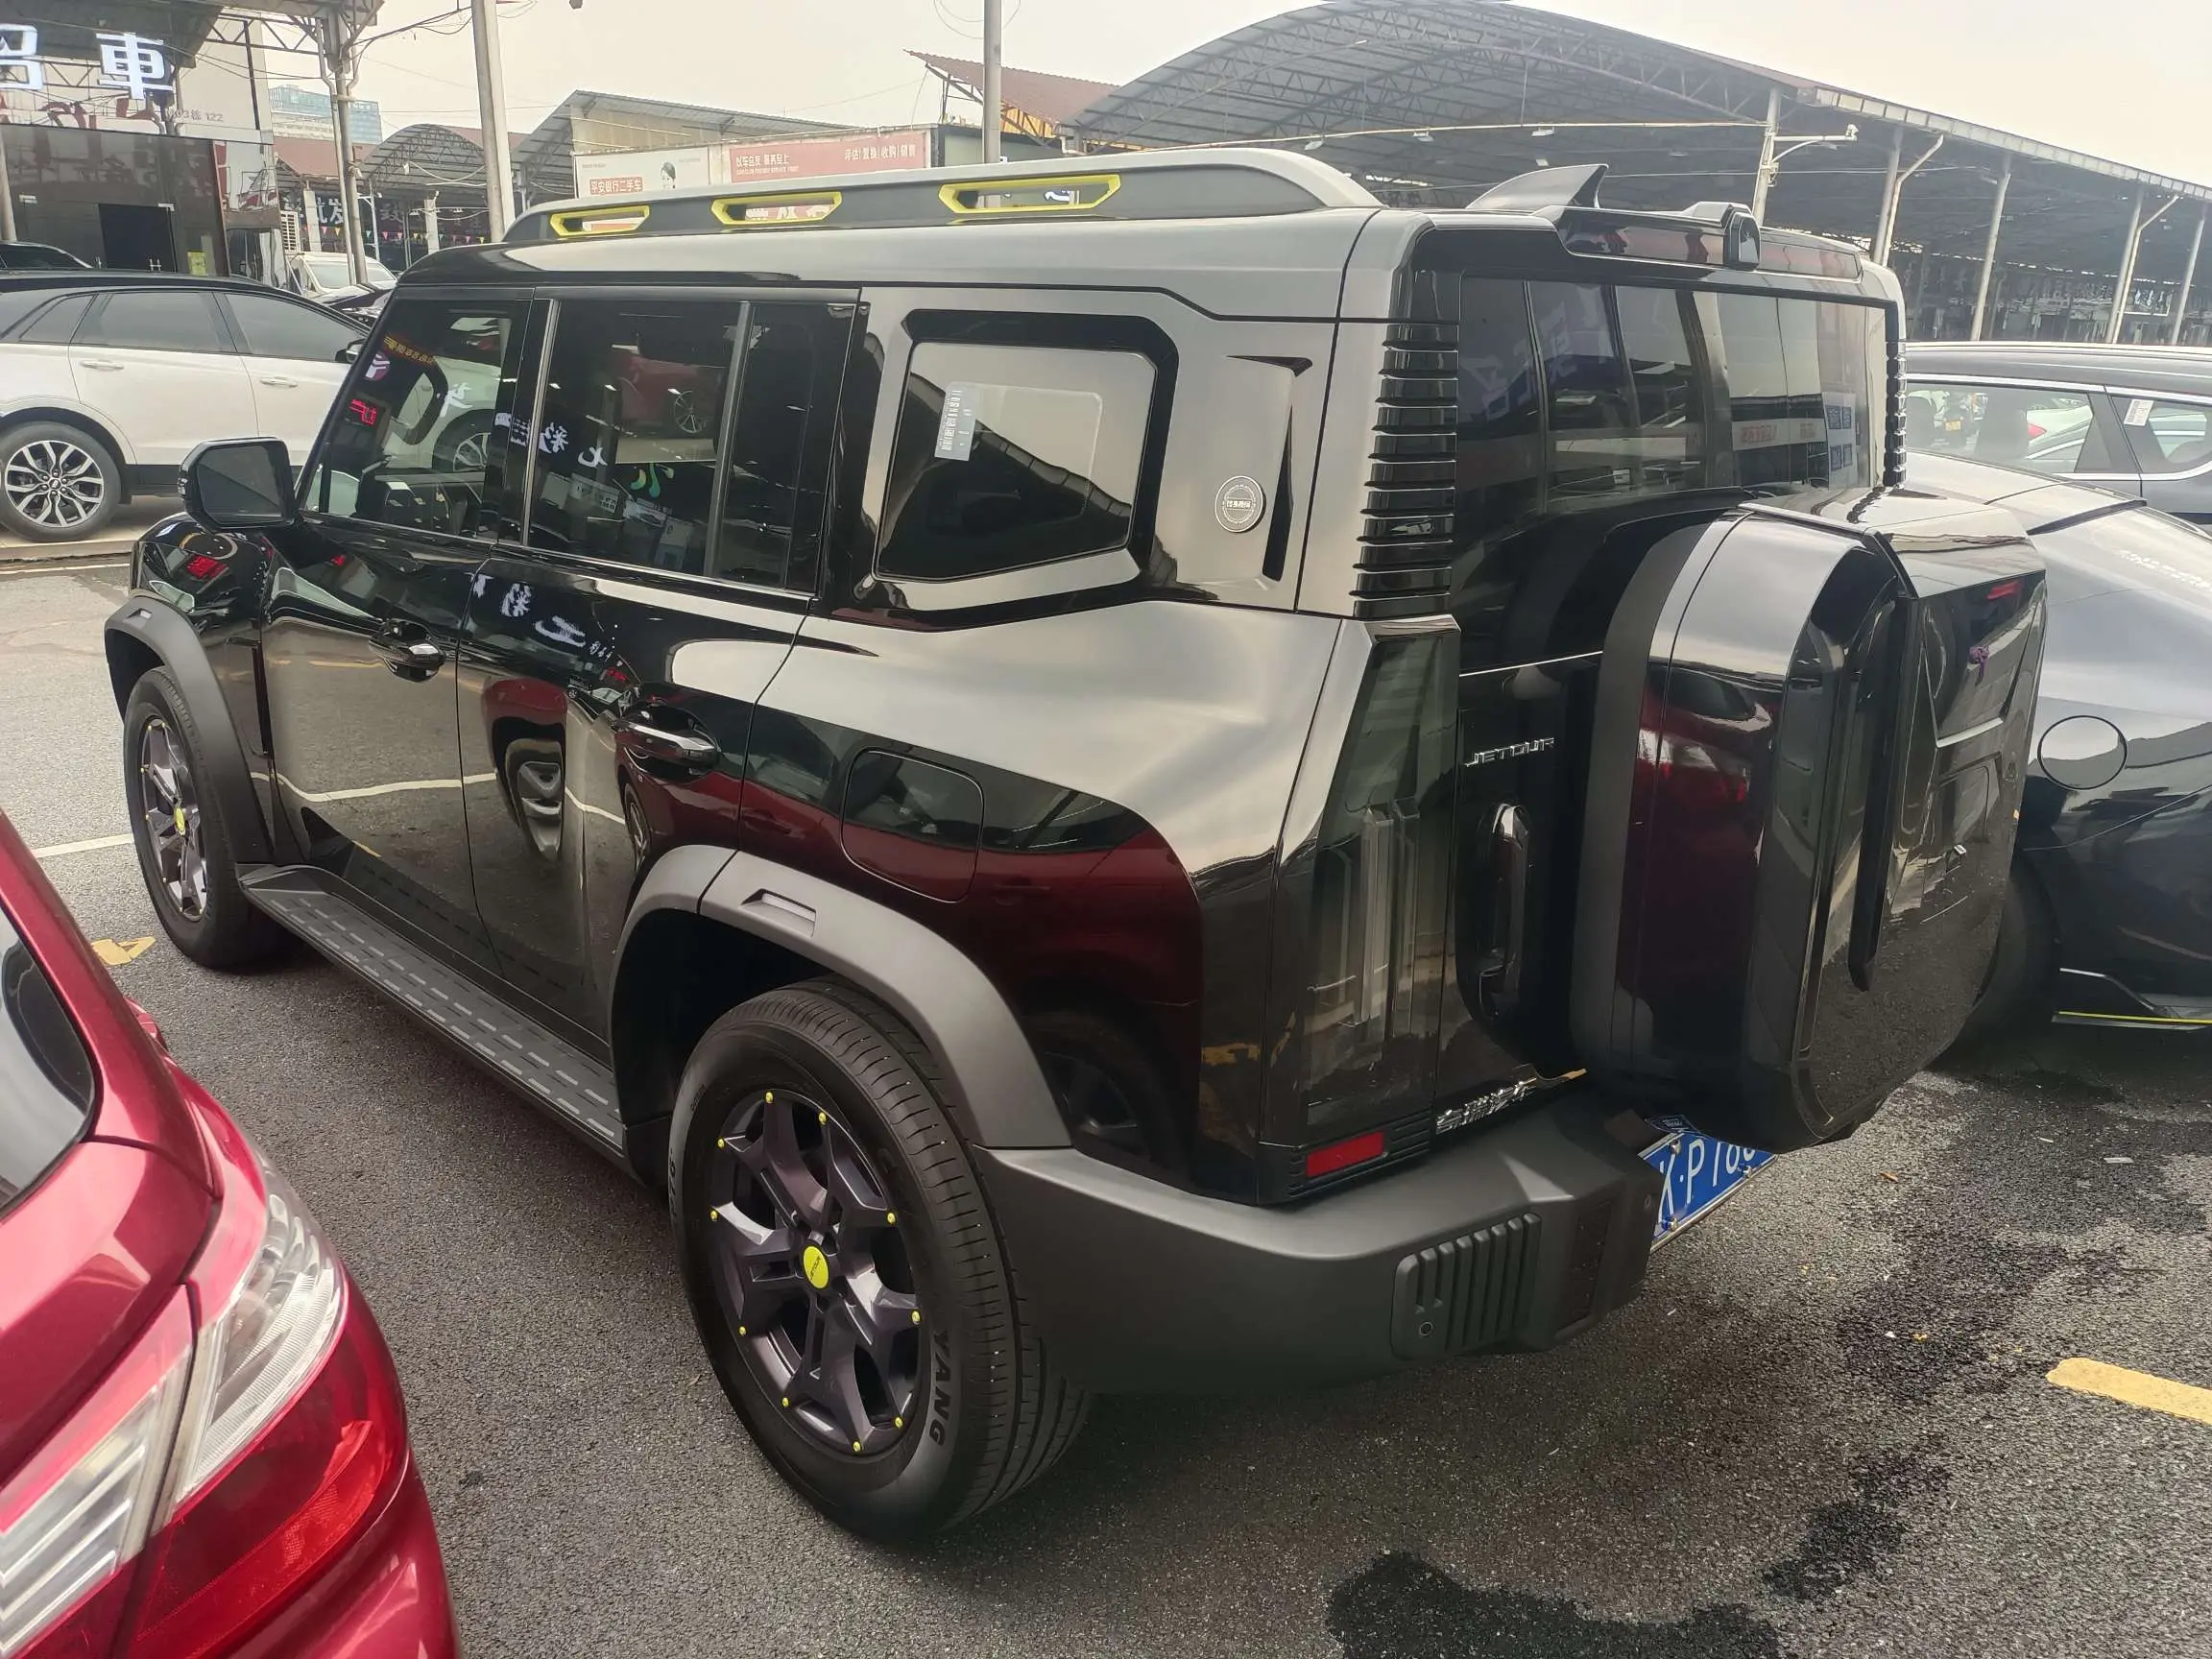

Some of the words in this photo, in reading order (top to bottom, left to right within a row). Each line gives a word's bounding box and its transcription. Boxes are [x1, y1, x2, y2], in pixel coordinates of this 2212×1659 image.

[590, 180, 642, 193] 平安银行二手车
[1462, 737, 1554, 767] JETOUR
[928, 1329, 951, 1446] YANG
